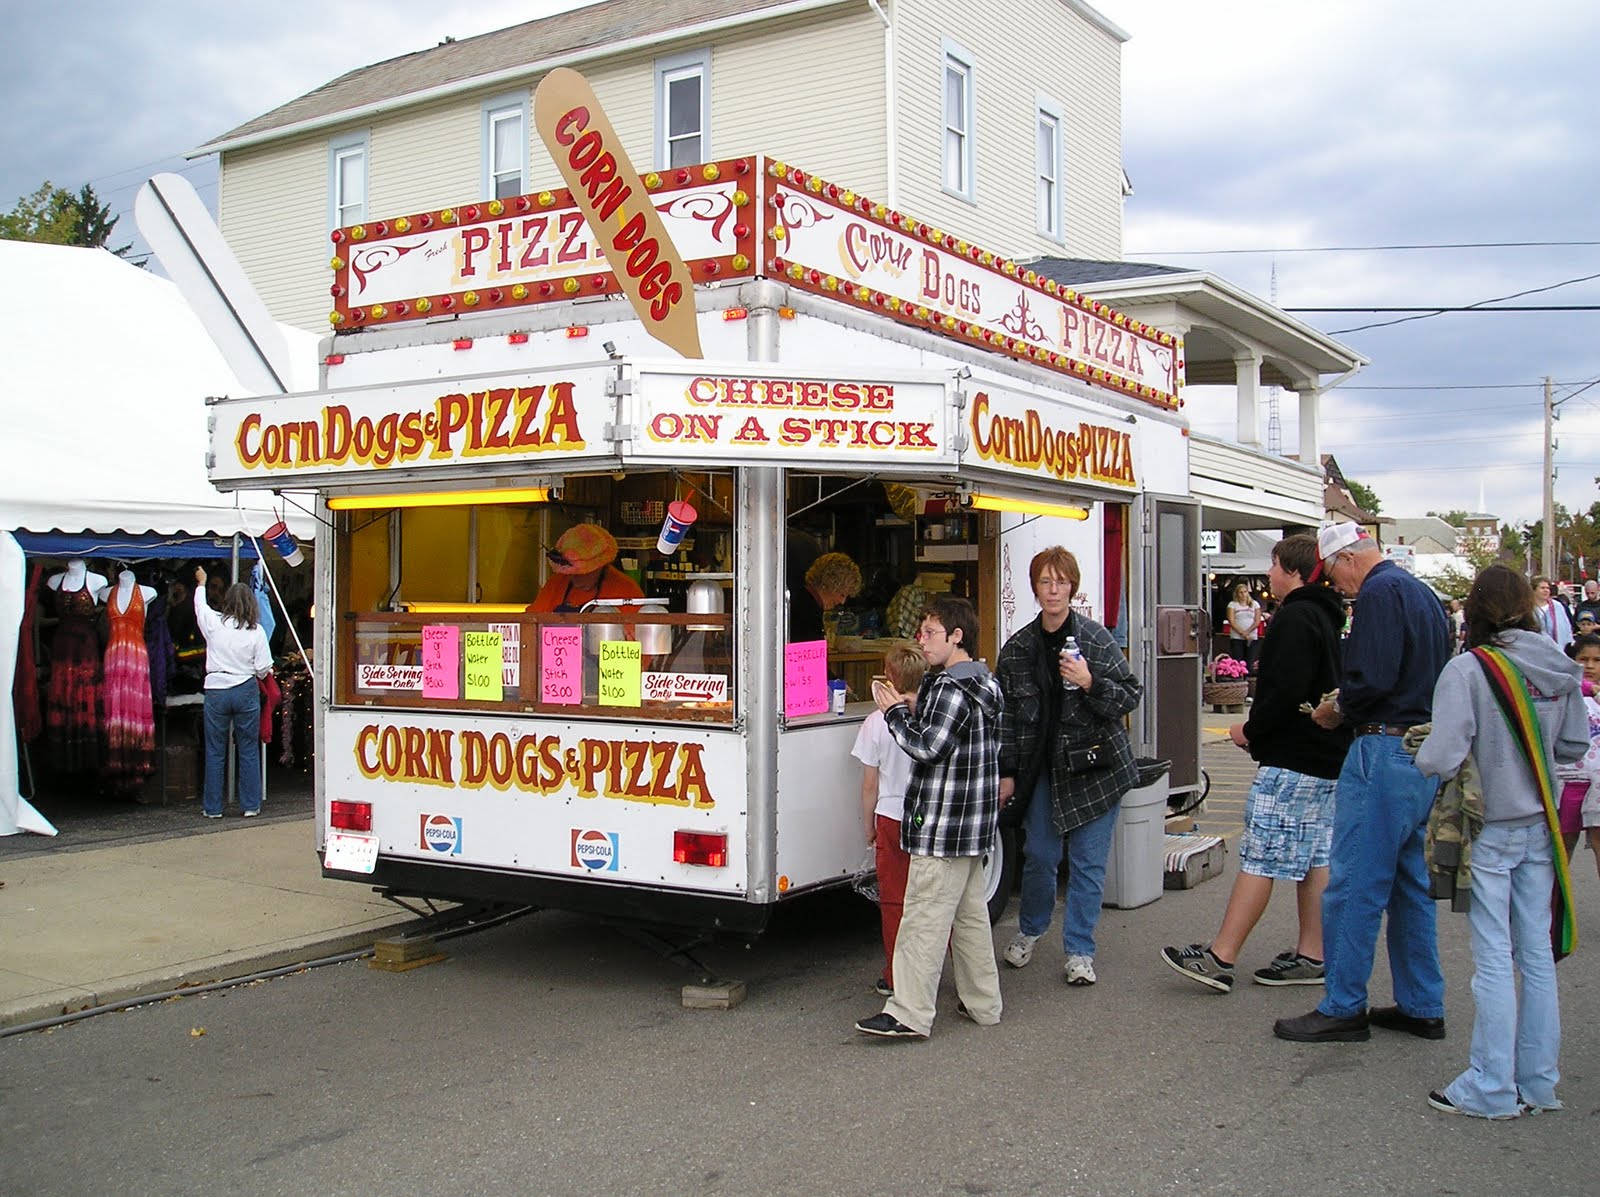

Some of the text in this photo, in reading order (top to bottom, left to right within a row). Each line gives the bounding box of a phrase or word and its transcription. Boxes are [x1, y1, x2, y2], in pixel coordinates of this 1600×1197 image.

[555, 106, 682, 321] CORN DOGS
[454, 211, 608, 283] PIZZ
[838, 222, 1144, 380] Corn DOGS PIZZA
[684, 377, 894, 413] CHEESE
[430, 382, 586, 459] PIZZA
[646, 413, 937, 450] ON A STICK
[1079, 423, 1136, 487] PIZZA
[424, 630, 448, 640] Cheese
[466, 634, 499, 647] Bottled
[543, 631, 579, 646] Cheese
[466, 653, 488, 664] Water
[554, 647, 567, 657] on
[602, 644, 640, 660] Bottled
[786, 648, 826, 662] ZZARELLA
[555, 657, 563, 666] a
[362, 665, 423, 683] Side Serving
[545, 668, 567, 679] Stick
[600, 667, 624, 679] Water
[393, 680, 416, 689] Only
[644, 673, 725, 695] Side Serving
[650, 689, 672, 699] Only
[353, 724, 456, 788] CORN
[459, 729, 566, 796] DOGS
[577, 737, 716, 810] PIZZA
